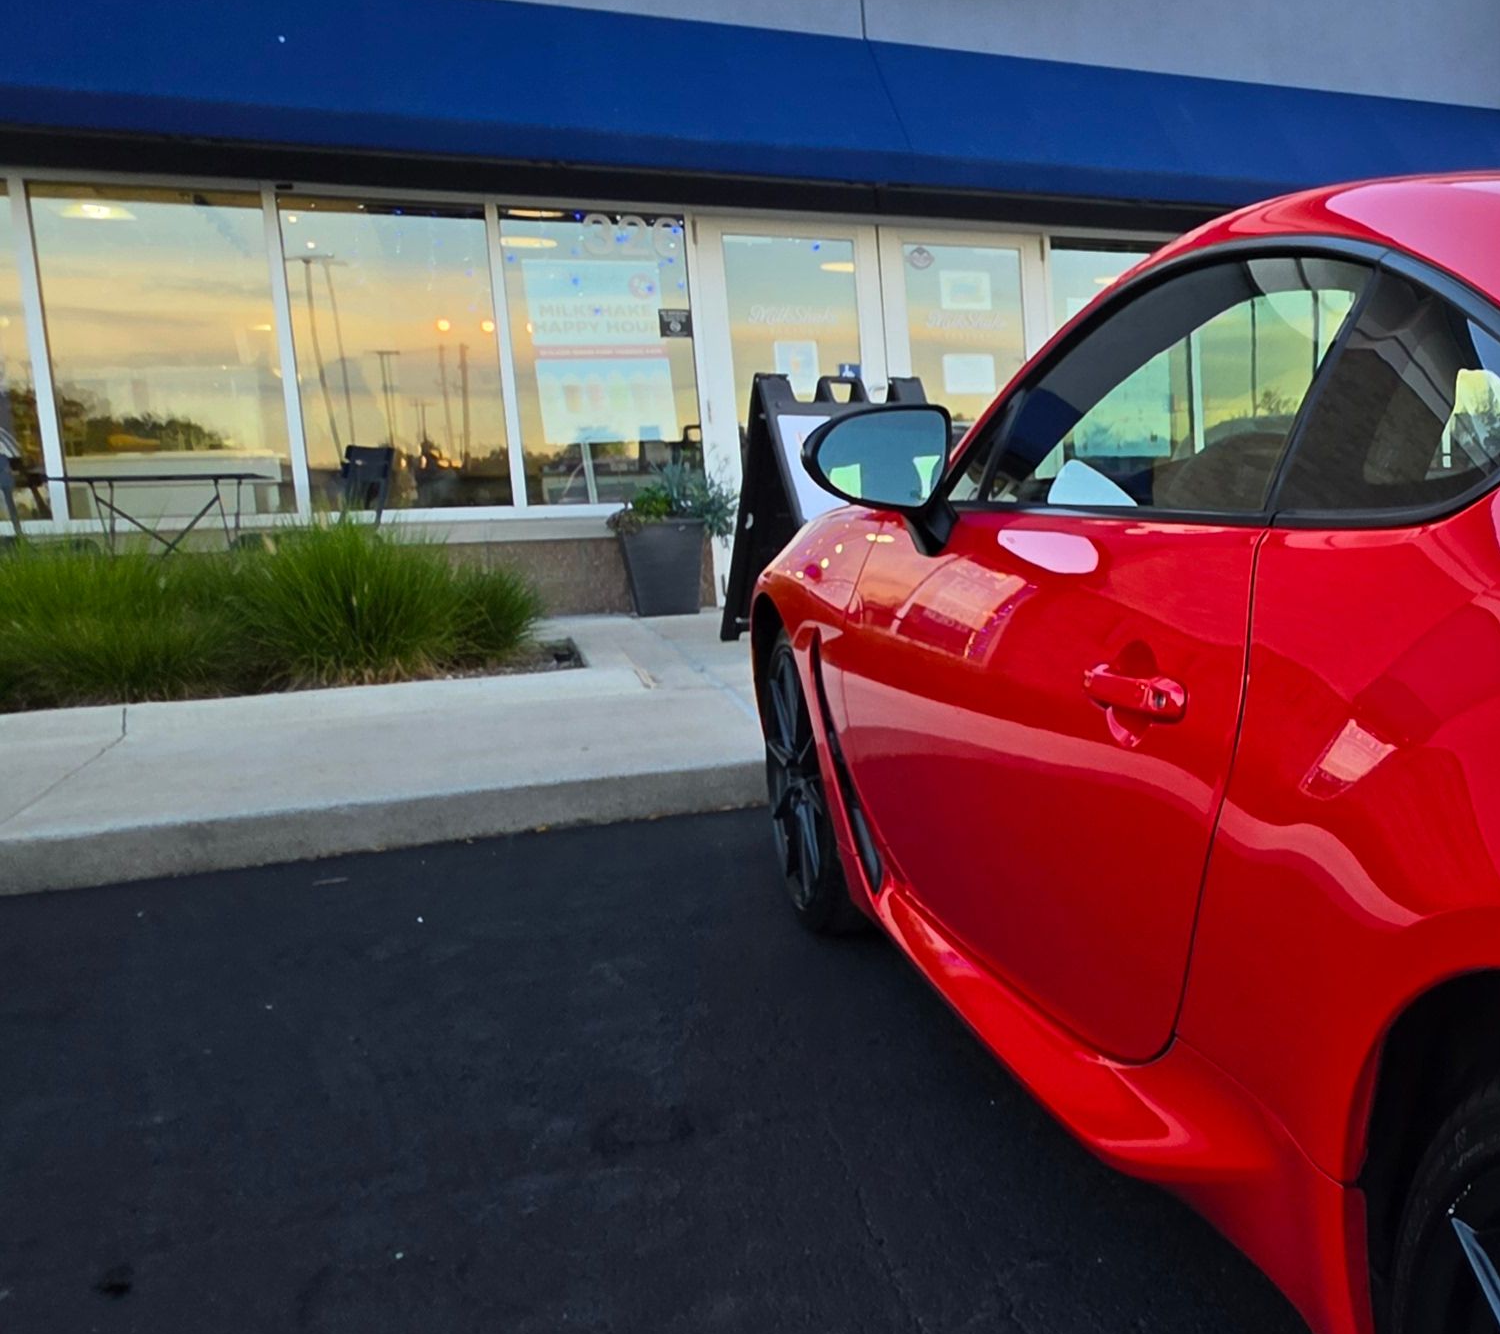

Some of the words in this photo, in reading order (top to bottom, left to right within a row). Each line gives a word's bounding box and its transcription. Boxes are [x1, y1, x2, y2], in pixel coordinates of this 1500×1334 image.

[582, 212, 682, 258] 326
[538, 303, 653, 318] MILKSHAKE
[534, 320, 600, 334] HAPPY
